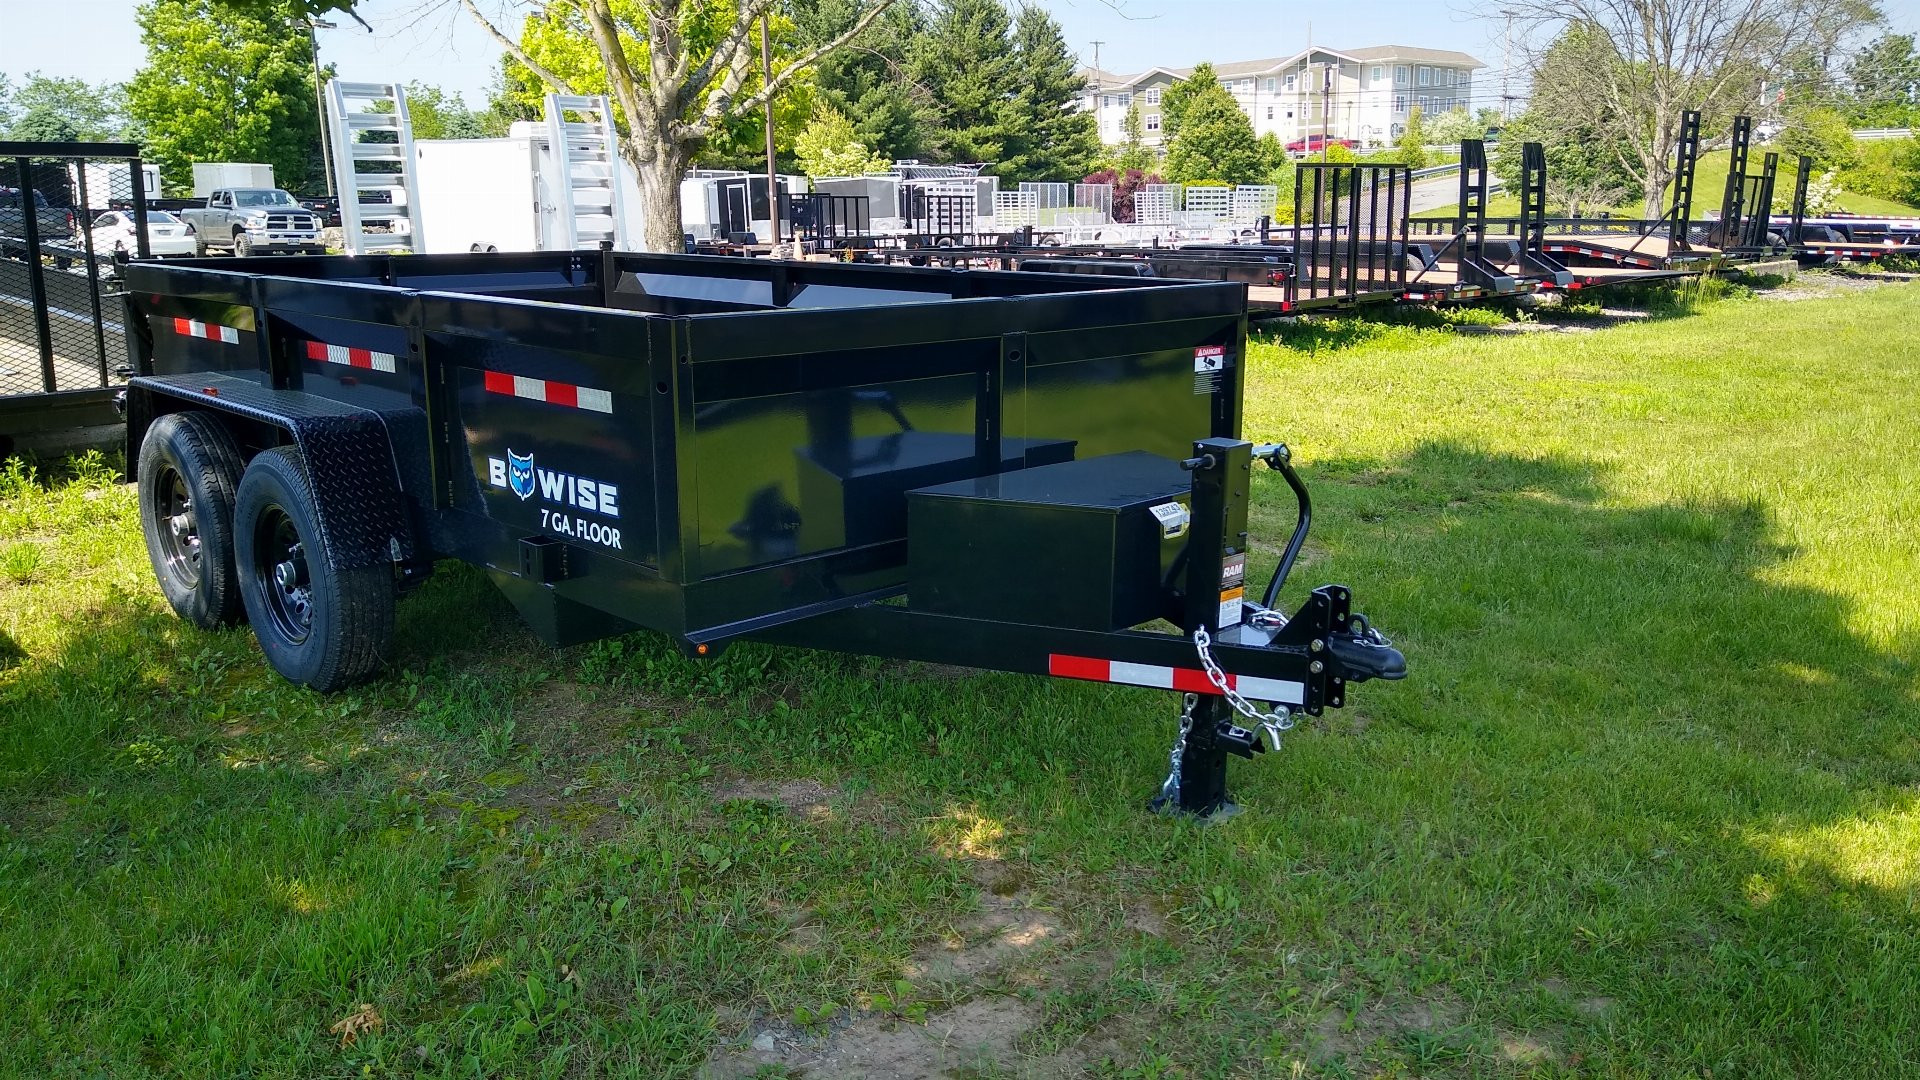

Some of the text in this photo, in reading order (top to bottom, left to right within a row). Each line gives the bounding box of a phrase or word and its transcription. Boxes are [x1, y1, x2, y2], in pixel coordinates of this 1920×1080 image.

[1202, 347, 1221, 356] DANGER
[541, 508, 622, 550] 7 GA. FLOOR
[1222, 563, 1244, 578] RAM
